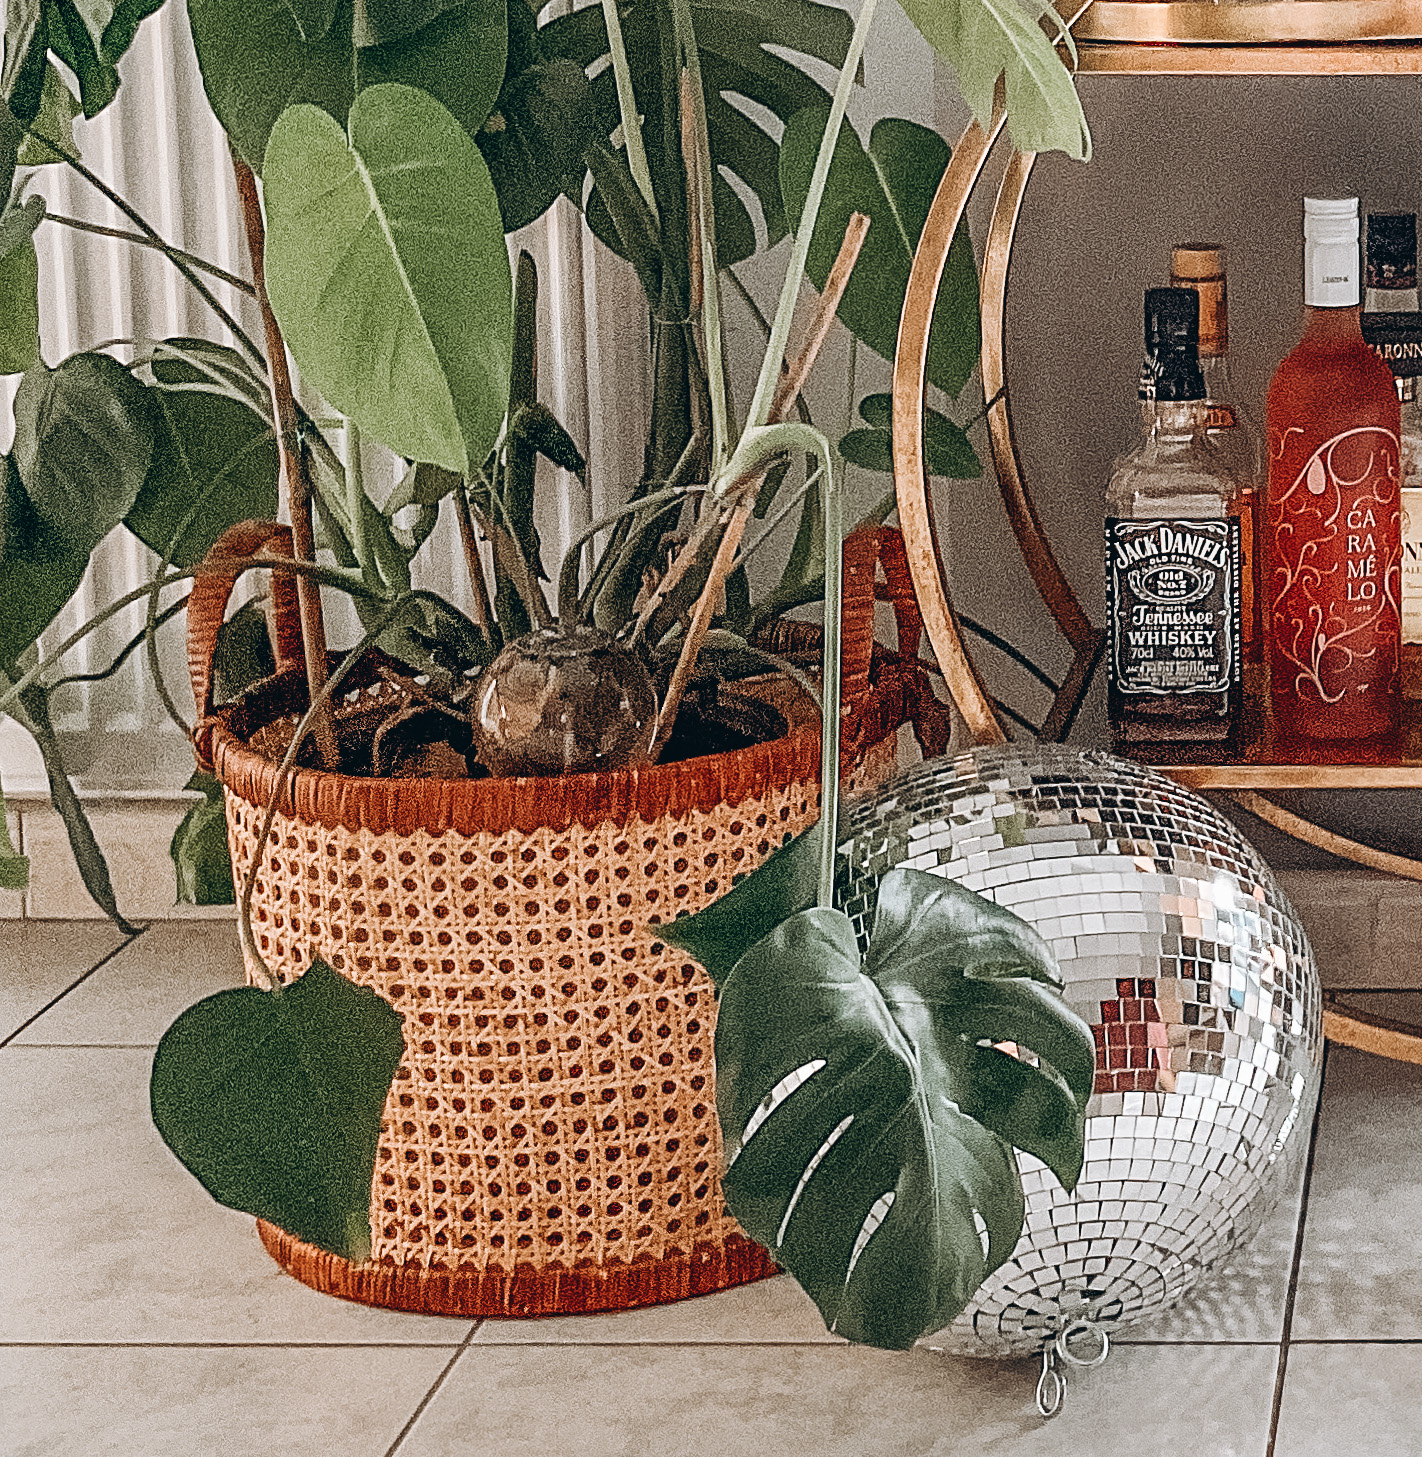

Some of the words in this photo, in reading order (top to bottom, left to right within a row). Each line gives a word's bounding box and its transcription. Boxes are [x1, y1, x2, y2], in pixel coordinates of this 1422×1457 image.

[1113, 534, 1159, 569] JACK
[1159, 527, 1230, 568] DANIEL'S
[1346, 533, 1377, 554] RA
[1158, 571, 1184, 581] Old
[1346, 581, 1377, 601] LO
[1132, 605, 1214, 625] Tennessee
[1126, 630, 1216, 646] WHISKEY
[1131, 646, 1154, 658] 70cl
[1172, 646, 1196, 658] 40%
